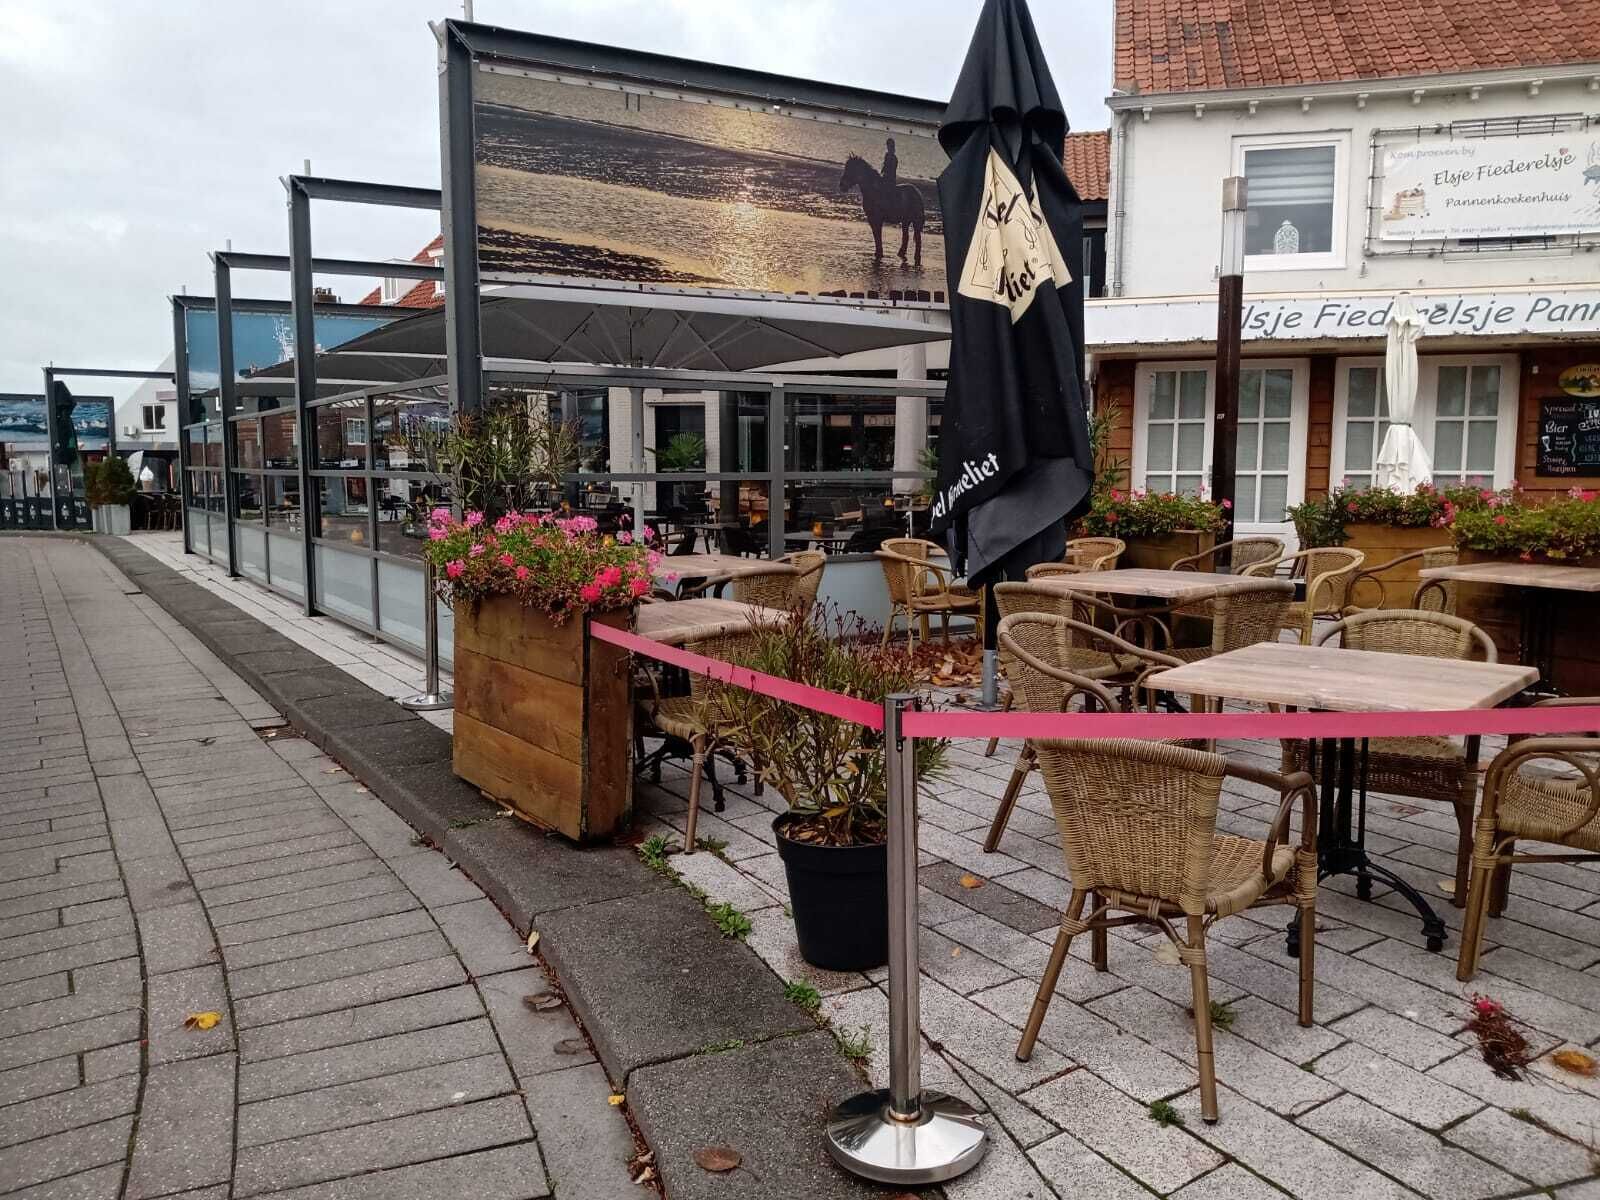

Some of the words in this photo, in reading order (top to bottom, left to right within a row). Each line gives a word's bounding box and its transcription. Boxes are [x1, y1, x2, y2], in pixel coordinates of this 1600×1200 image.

[1433, 169, 1474, 188] Elsje
[1477, 151, 1577, 181] Fiederelsje
[1444, 191, 1571, 208] Pannenkoekenhuis
[1241, 304, 1303, 336] lsje
[1313, 299, 1515, 331] Fiedrelsje
[1545, 420, 1569, 433] Bier
